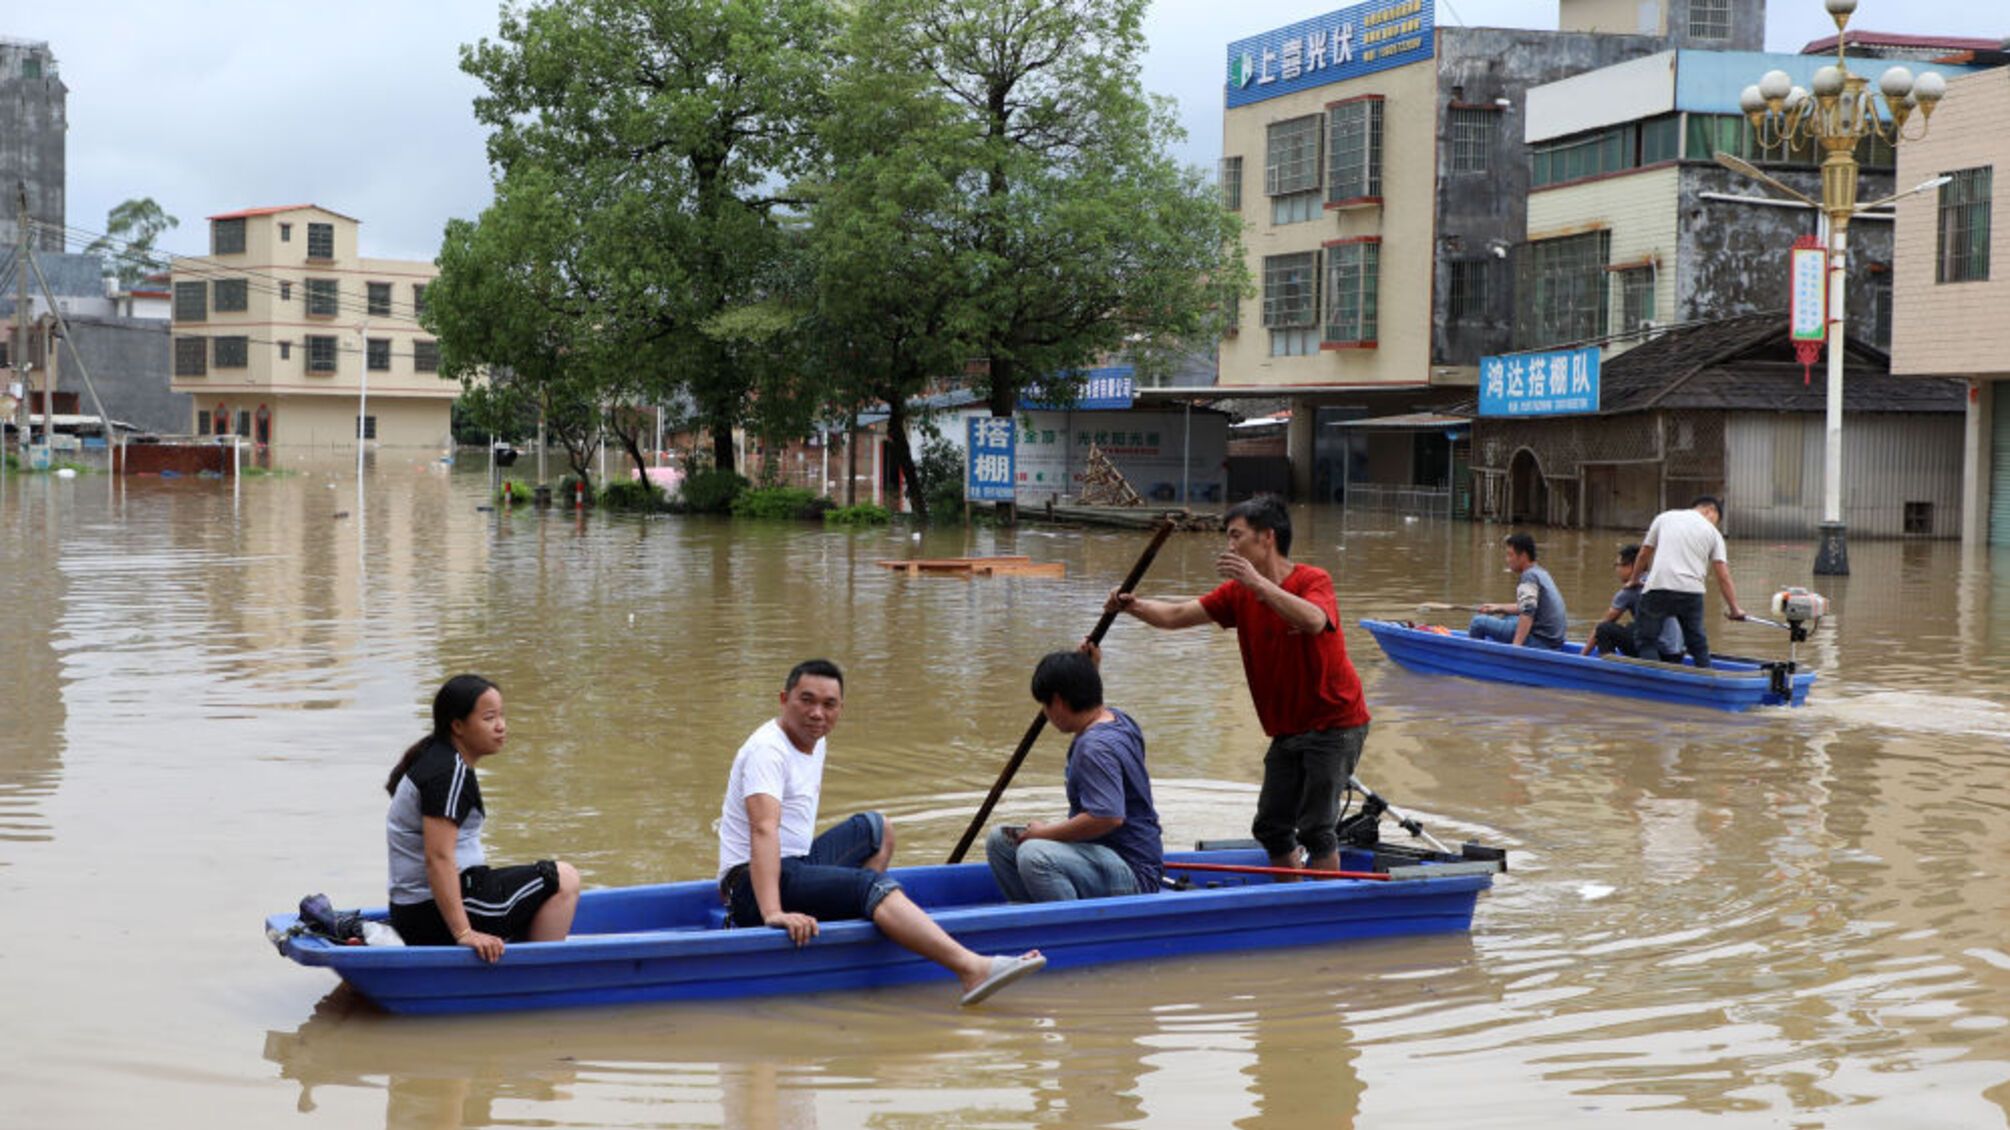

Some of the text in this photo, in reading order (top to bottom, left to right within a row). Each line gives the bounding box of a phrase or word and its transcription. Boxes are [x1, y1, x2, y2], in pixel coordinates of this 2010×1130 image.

[1486, 352, 1591, 399] 鸿达搭棚队
[974, 417, 1010, 483] 搭棚
